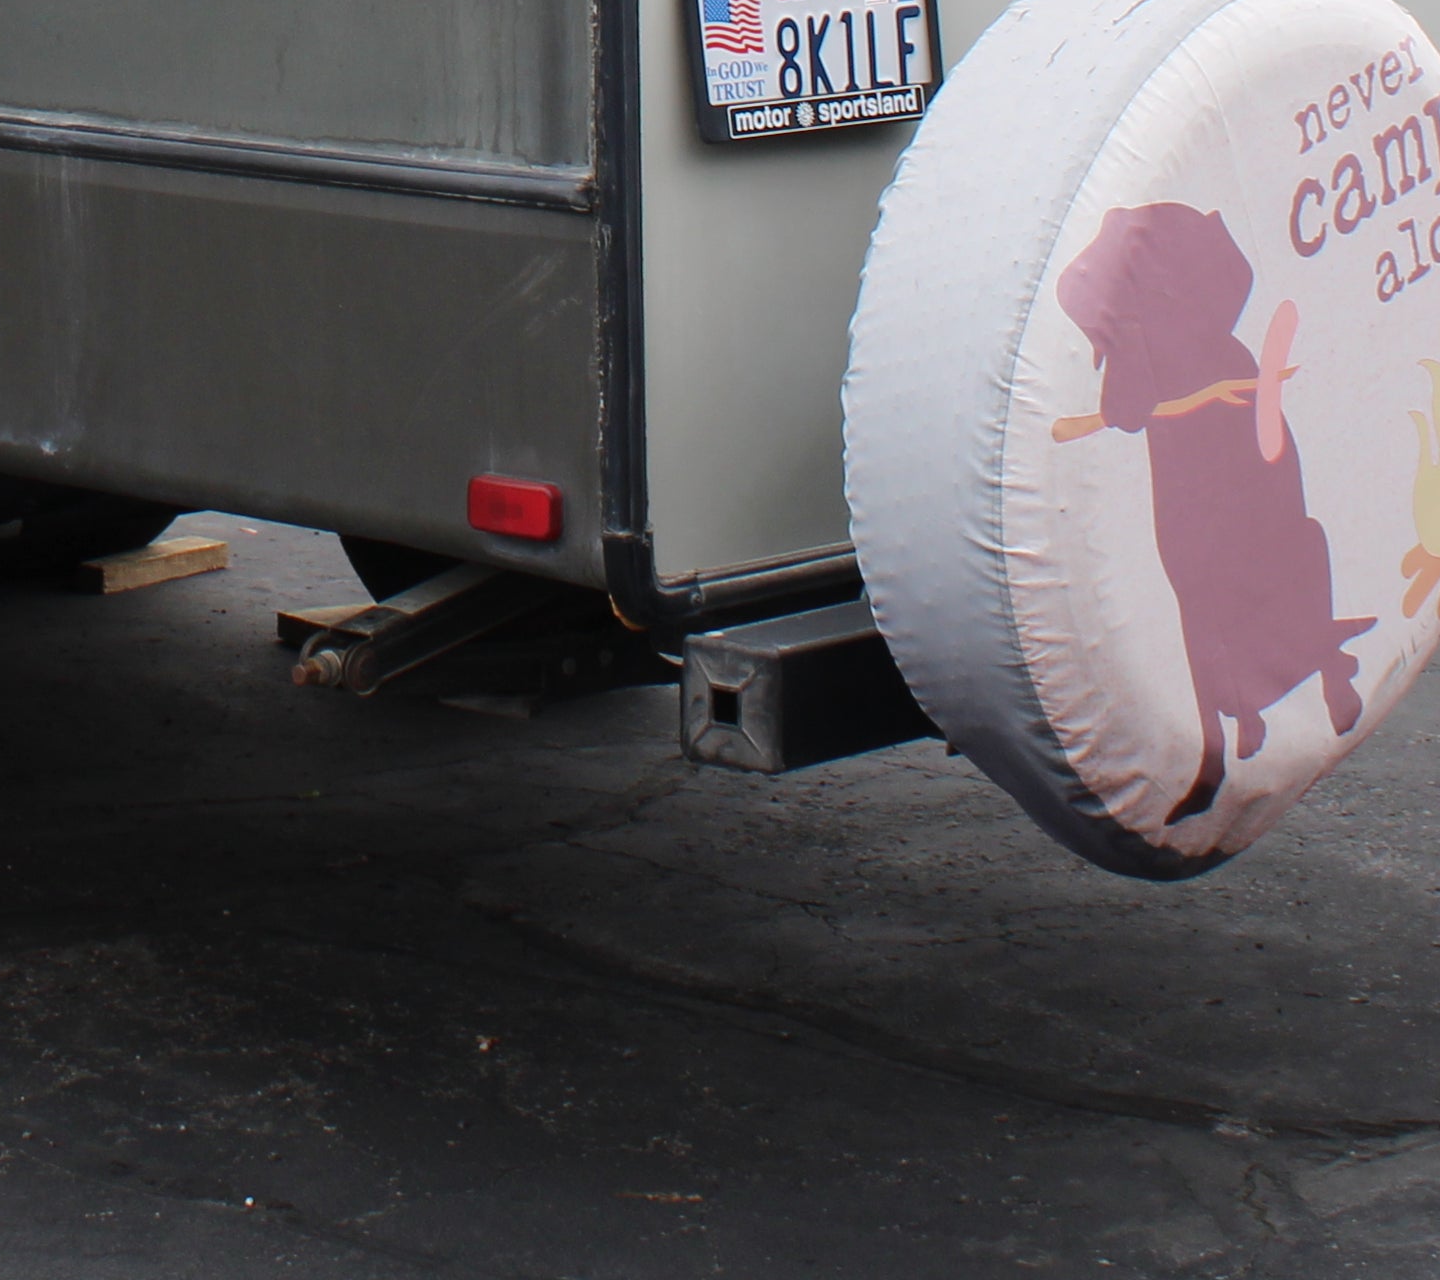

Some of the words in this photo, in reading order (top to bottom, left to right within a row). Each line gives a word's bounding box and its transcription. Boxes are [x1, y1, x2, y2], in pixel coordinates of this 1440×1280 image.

[706, 66, 718, 78] In
[719, 59, 753, 80] GOD
[776, 5, 921, 98] 8K1LF
[712, 79, 766, 102] TRUST
[735, 106, 792, 132] motor
[818, 88, 918, 126] sportsland
[1294, 34, 1424, 155] never
